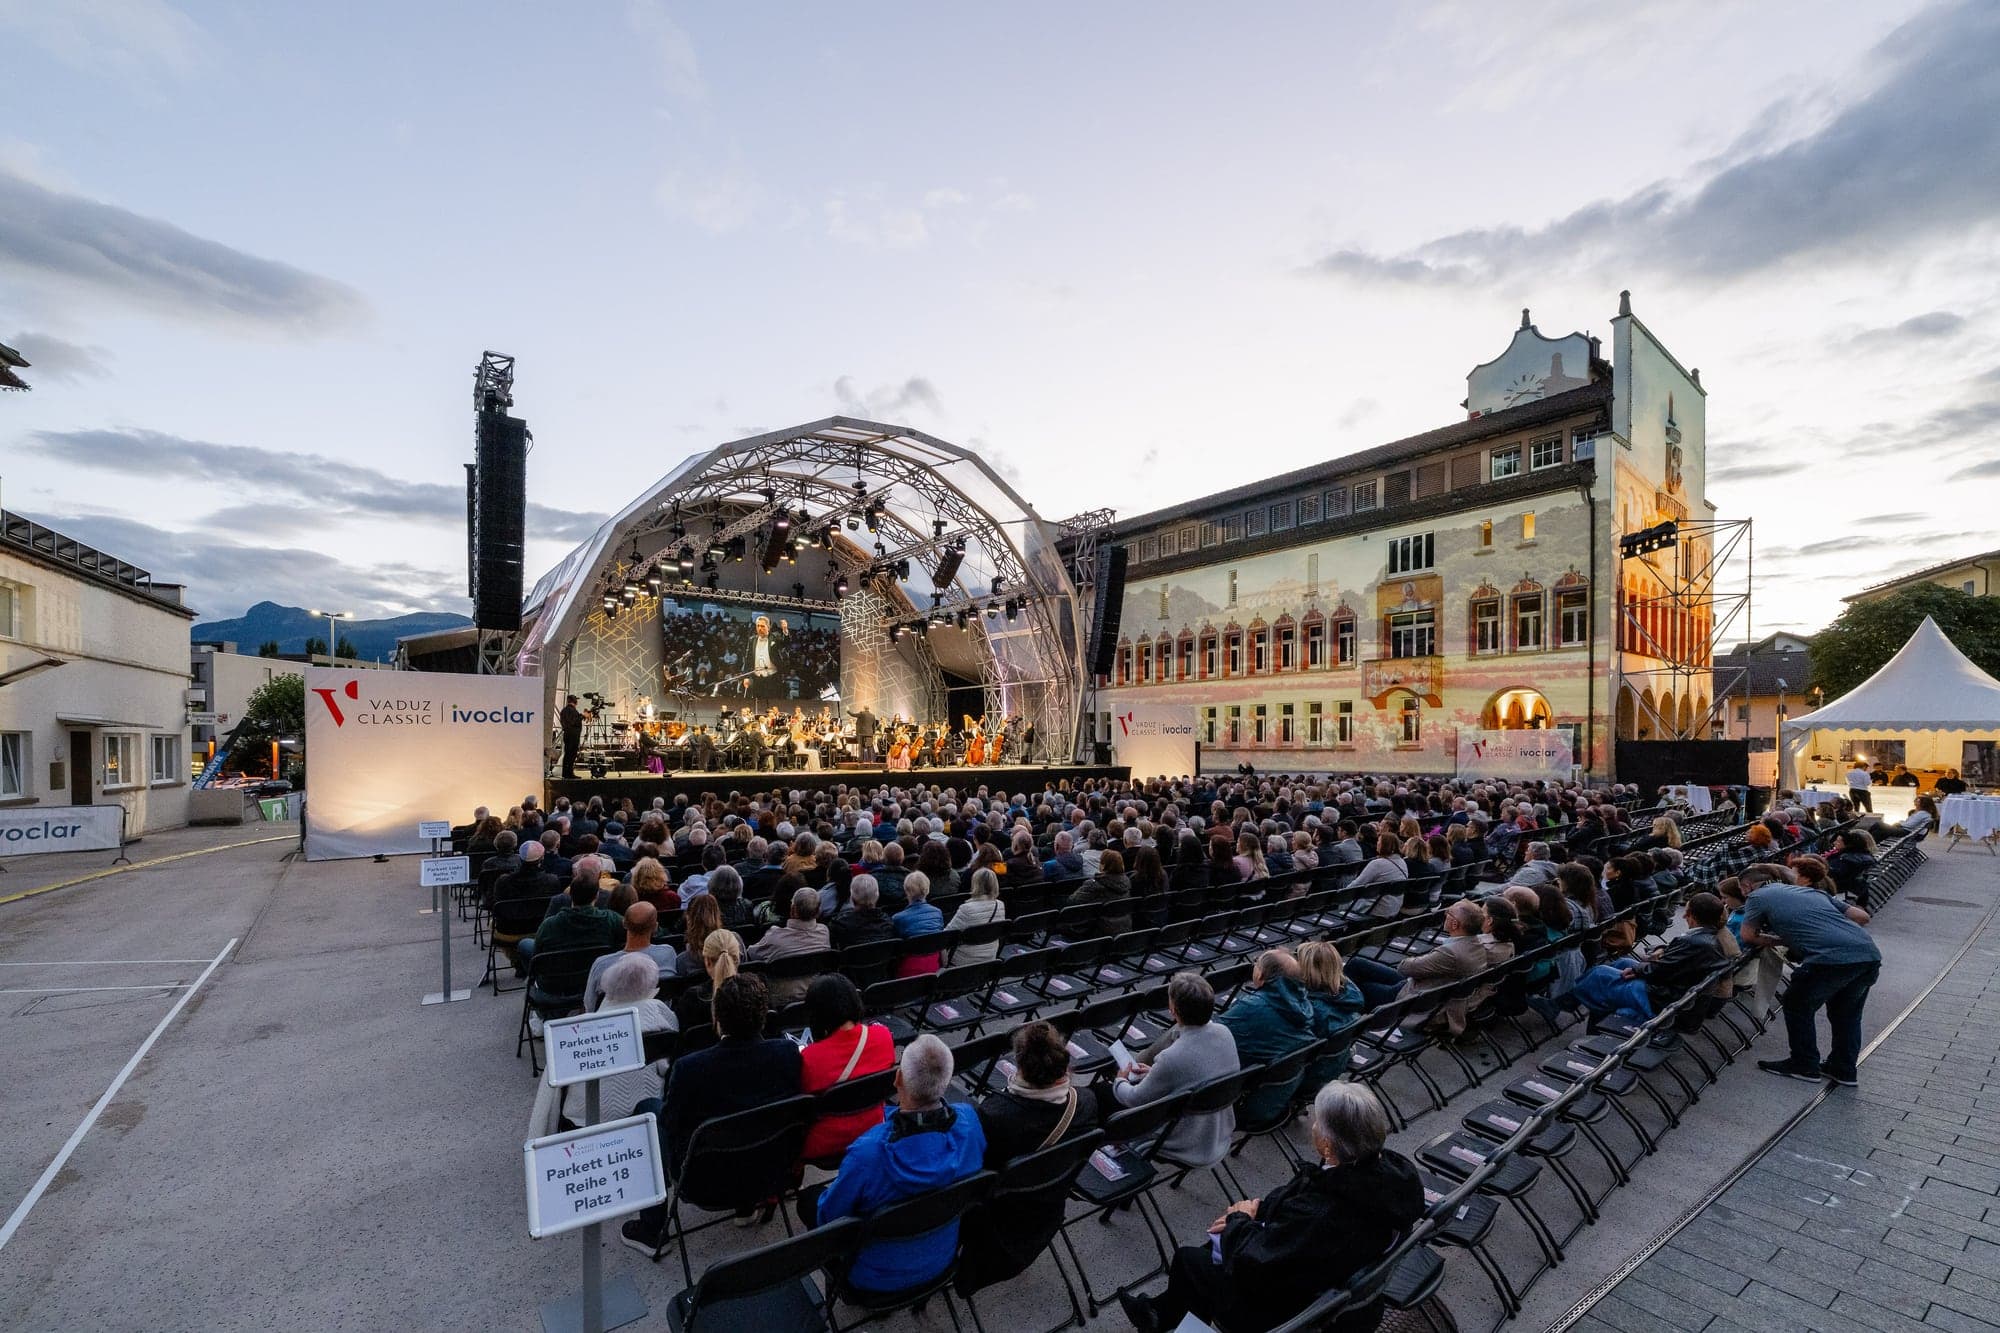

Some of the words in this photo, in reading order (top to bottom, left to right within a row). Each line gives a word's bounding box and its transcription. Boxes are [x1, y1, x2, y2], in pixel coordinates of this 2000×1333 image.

[369, 700, 432, 712] VADUZ
[452, 703, 535, 724] ivoclar
[357, 713, 432, 726] CLASSIC
[1162, 724, 1192, 735] ivoclar
[1519, 747, 1557, 757] ivoclar
[560, 1035, 600, 1050] Parkett
[603, 1030, 629, 1041] Links
[573, 1047, 603, 1060] Reihe
[606, 1043, 620, 1053] 15
[580, 1060, 606, 1071] Platz
[610, 1056, 615, 1065] 1
[599, 1138, 625, 1149] ivoclar
[546, 1158, 603, 1182] Parkett
[607, 1148, 644, 1165] Links
[565, 1176, 608, 1196] Reihe
[612, 1167, 631, 1182] 18
[574, 1193, 612, 1213] Platz
[616, 1187, 624, 1200] 1
